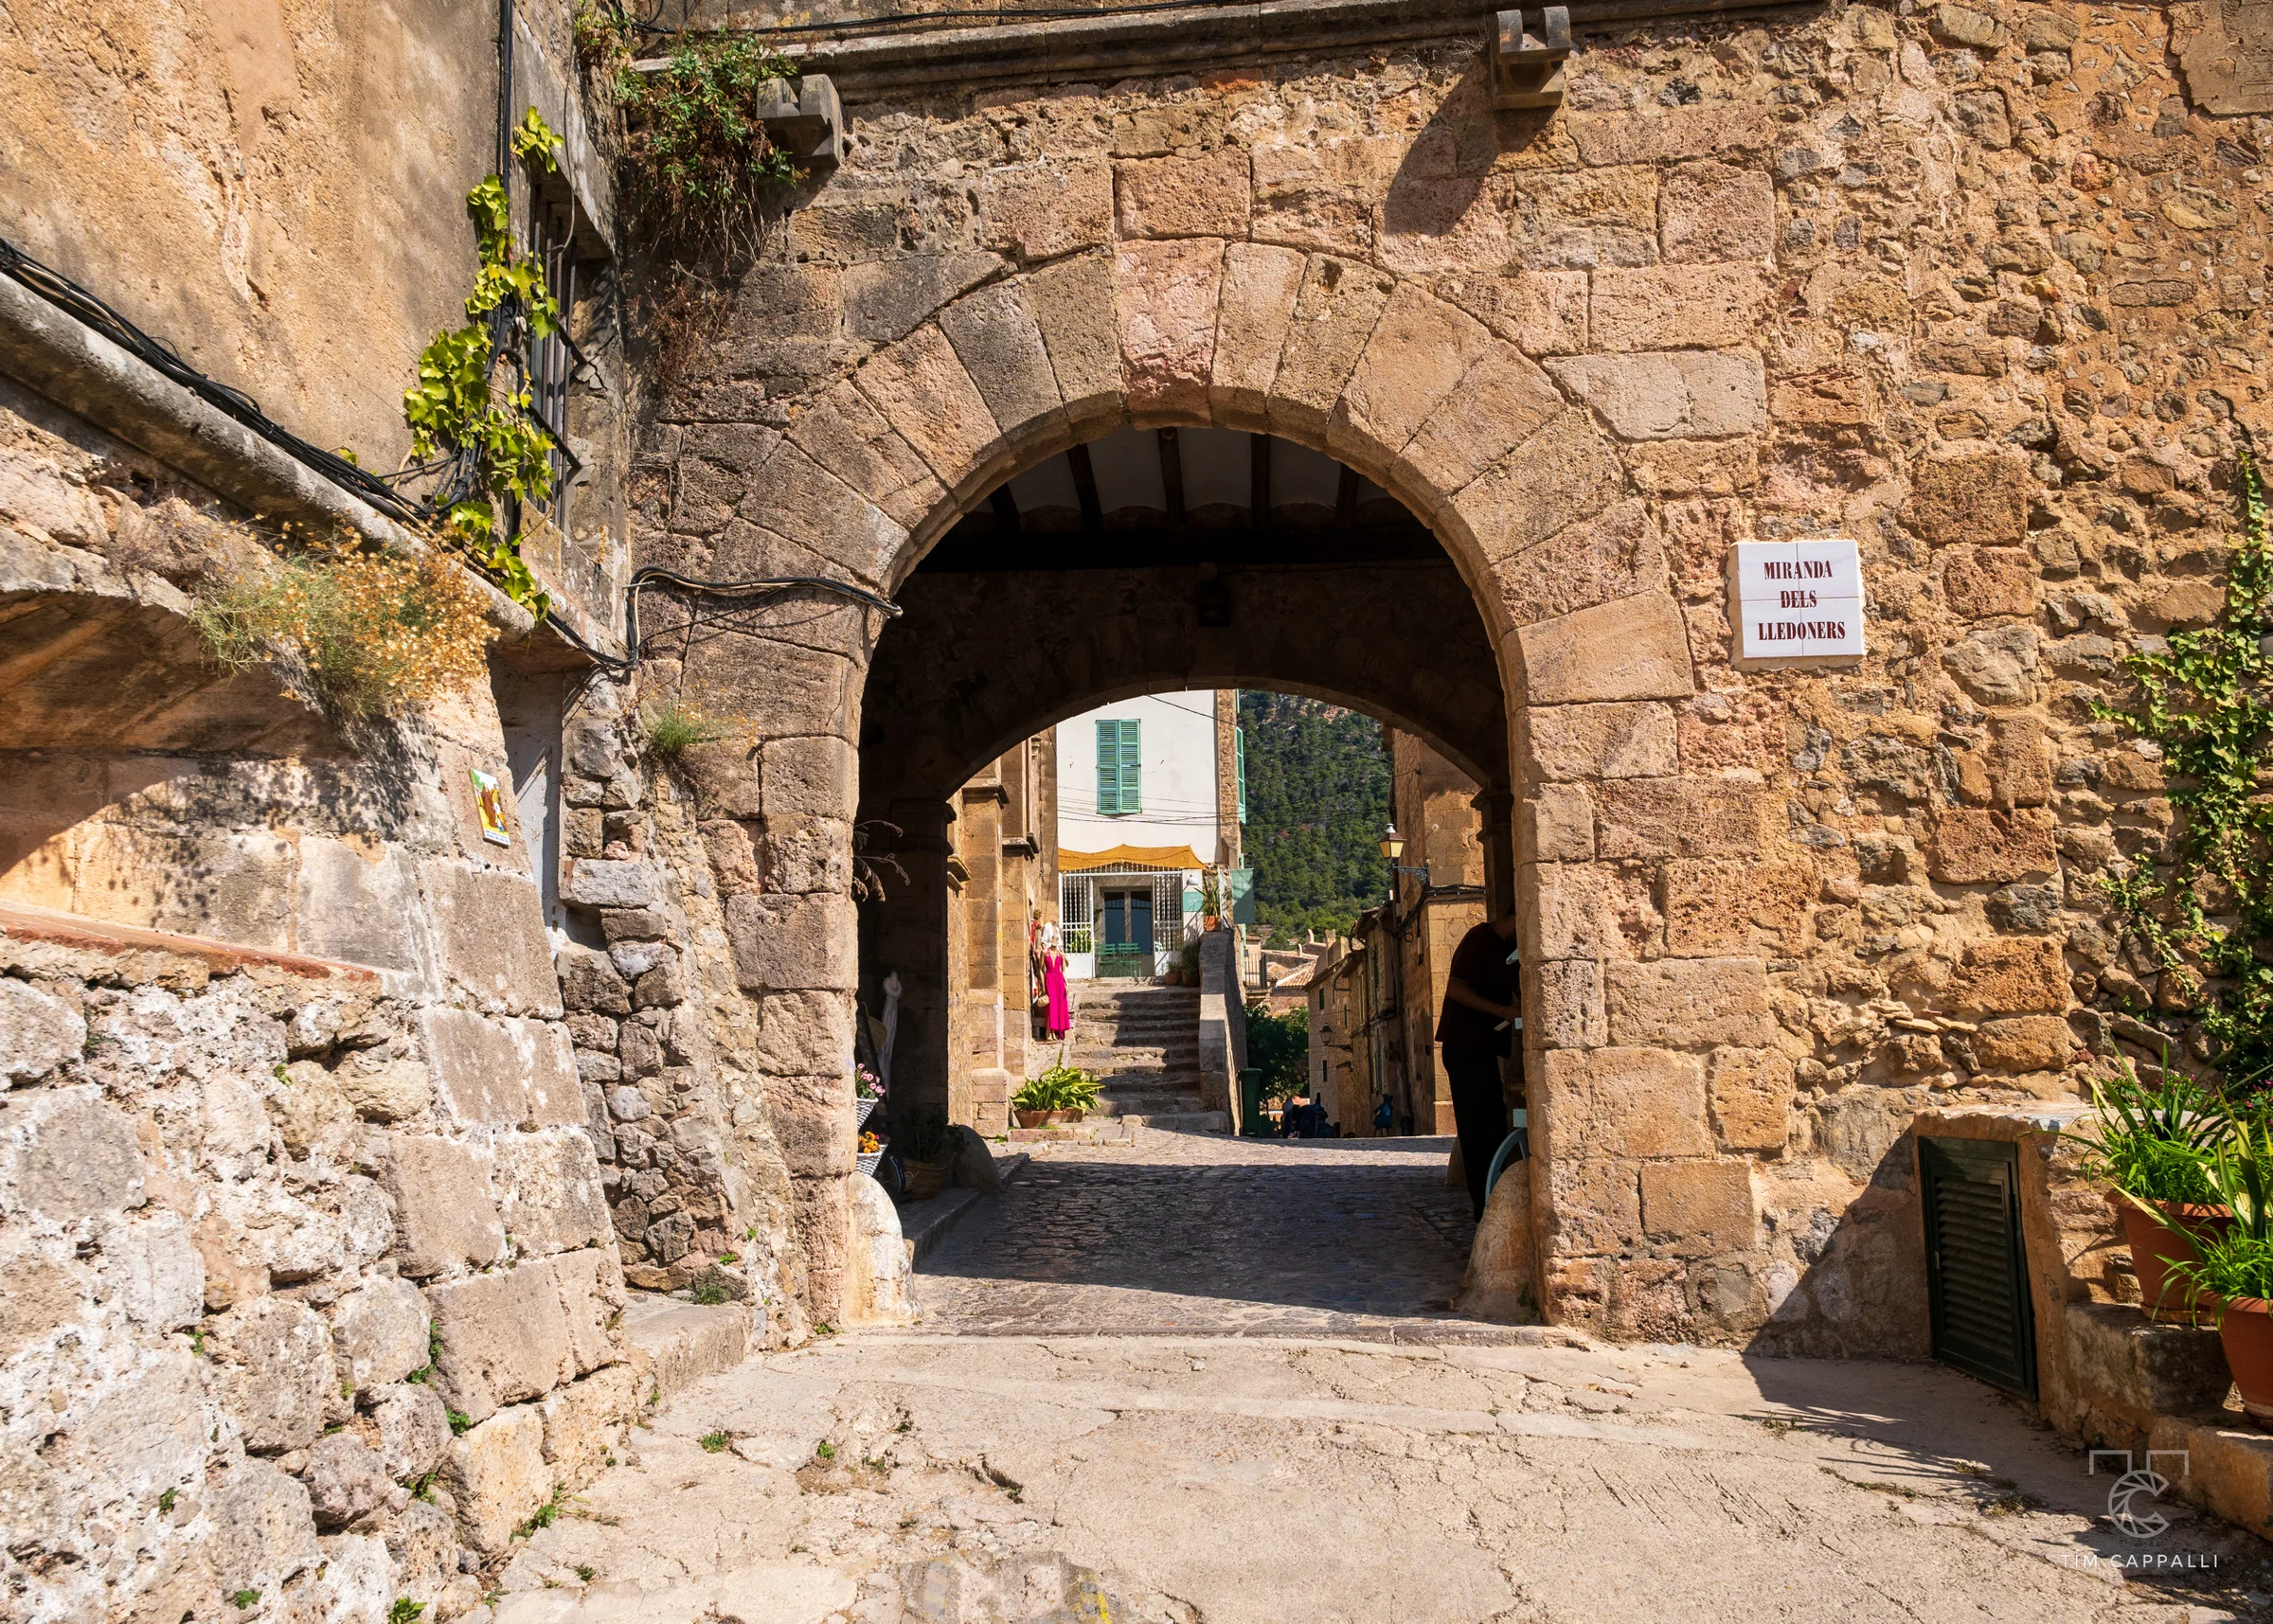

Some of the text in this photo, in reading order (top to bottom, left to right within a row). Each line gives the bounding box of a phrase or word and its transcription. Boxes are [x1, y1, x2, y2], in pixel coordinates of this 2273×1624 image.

[1763, 561, 1833, 580] MIRANDA
[1780, 590, 1817, 608] DELS
[1758, 621, 1846, 640] LLEDONERS
